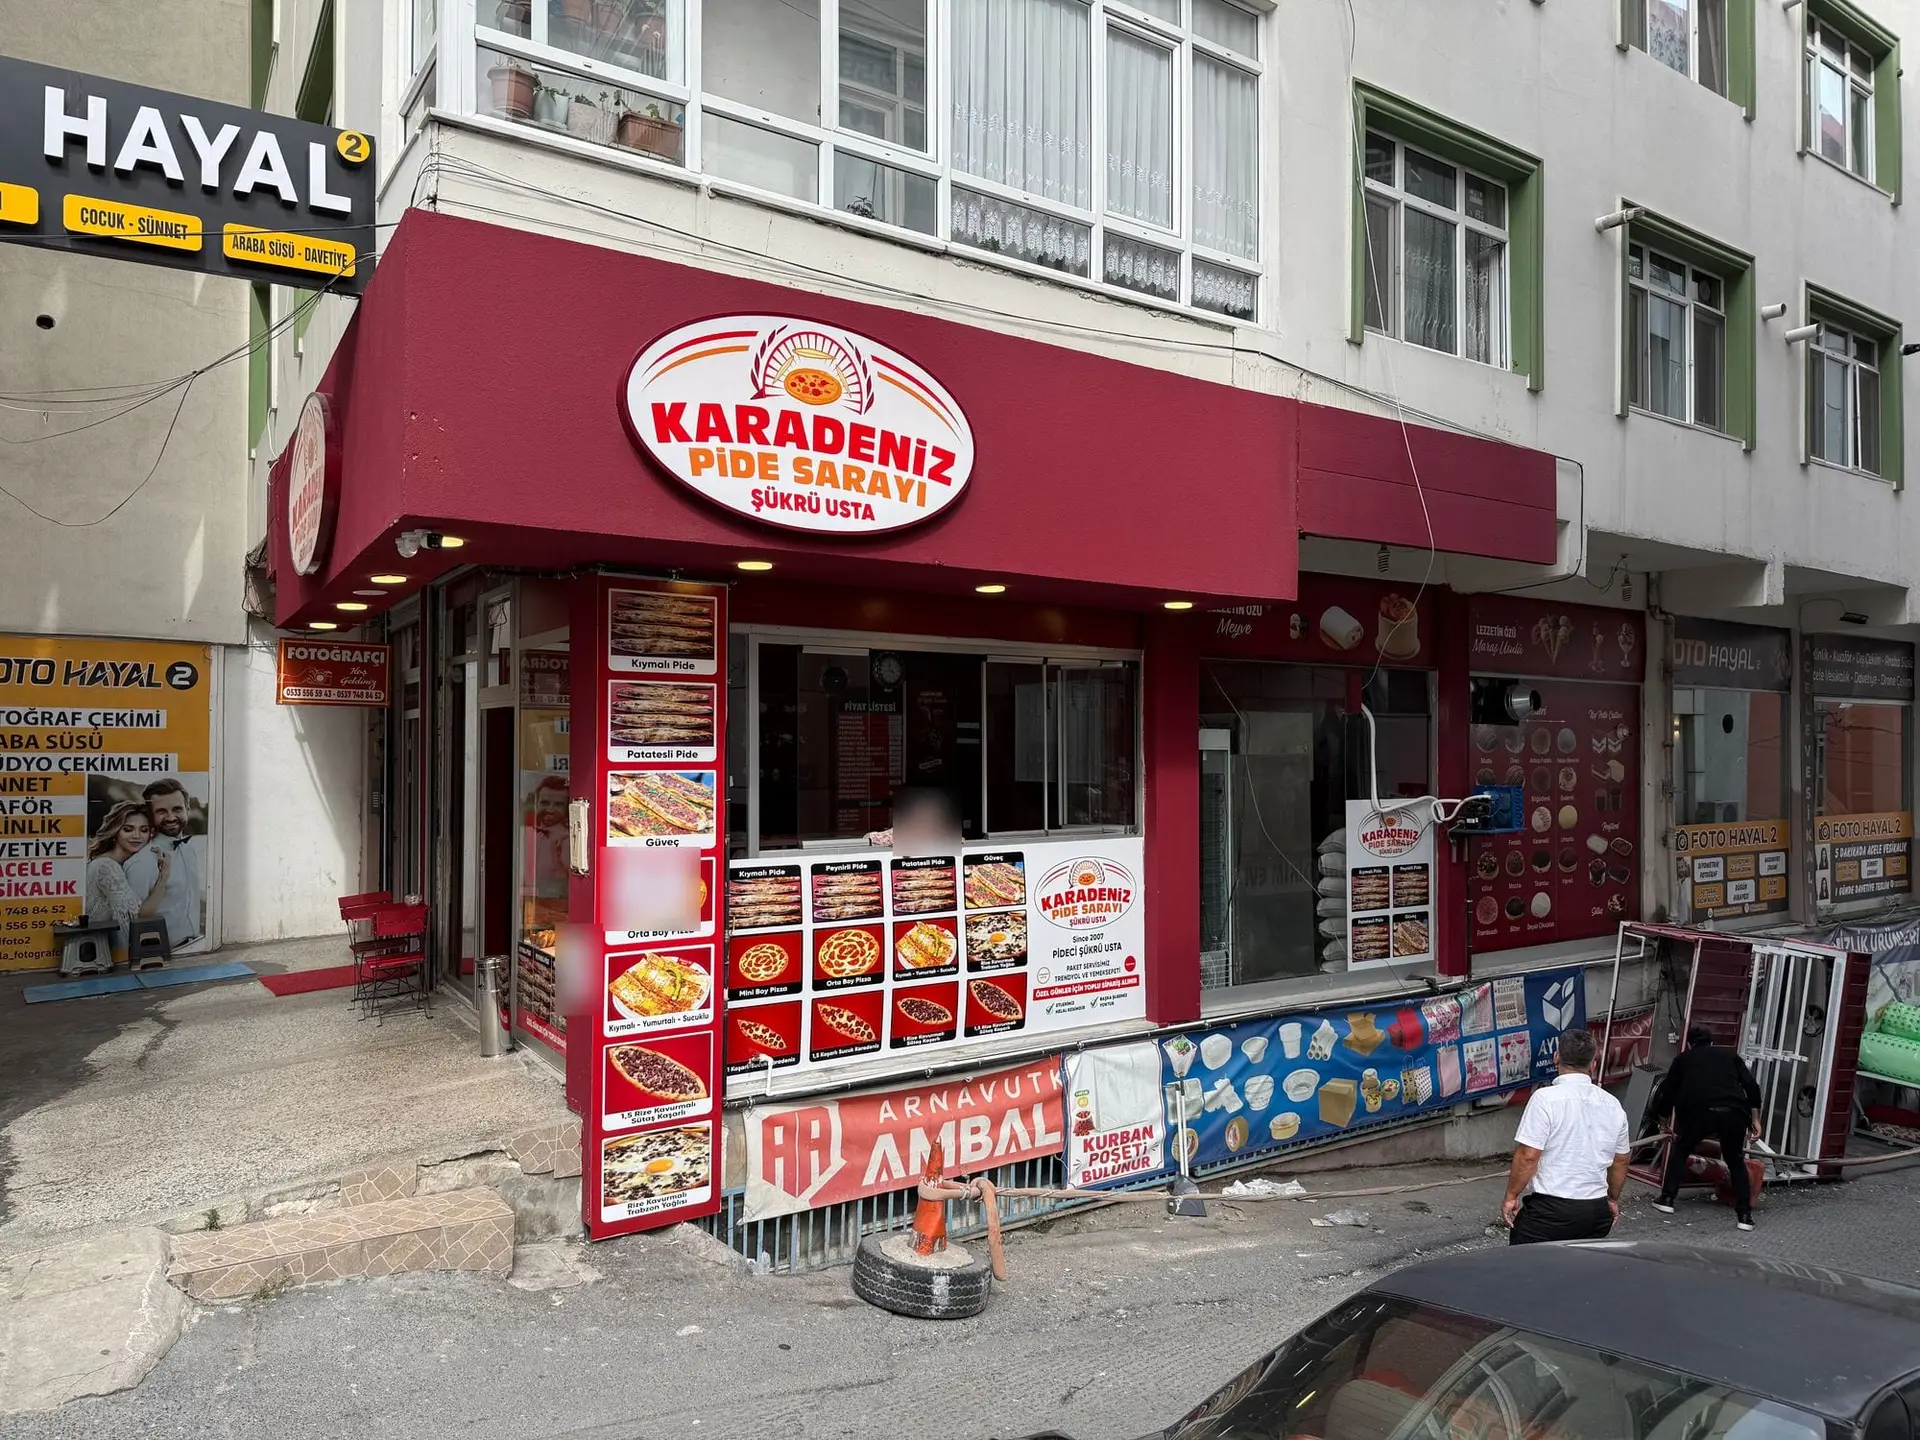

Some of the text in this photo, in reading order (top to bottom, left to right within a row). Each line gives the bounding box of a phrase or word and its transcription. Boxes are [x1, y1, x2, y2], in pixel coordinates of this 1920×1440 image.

[44, 86, 363, 213] HAYAL 2
[81, 207, 188, 241] ÇOCUK SÜNNET
[232, 234, 348, 269] ARABA SÜSÜ DAVETİYE
[791, 457, 927, 508] SARAYI
[750, 486, 876, 521] ŞÜKRÜ USTA
[287, 646, 385, 667] FOTOĞRAFÇI
[631, 658, 696, 671] Kıymalı Pide
[1709, 645, 1755, 671] HAYAL
[63, 660, 162, 689] HAYAL
[171, 666, 193, 686] 2
[88, 709, 161, 731] ÇEKİMİ
[46, 732, 103, 750] SÜSÜ
[627, 749, 699, 760] Patatesli Pide
[0, 754, 169, 776] DYO ÇEKİMLERİ
[0, 816, 62, 835] İNLİK
[1832, 819, 1901, 839] FOTO HAYAL 2
[645, 837, 680, 848] Güveç
[1691, 826, 1777, 849] FOTO HAYAL 2
[5, 905, 66, 916] 748 84 52
[1082, 903, 1122, 915] SARAYI
[6, 921, 28, 930] 556
[31, 920, 46, 929] 59
[1069, 916, 1107, 928] ŞÜKRÜ USTA
[0, 936, 31, 946] foto2
[1073, 933, 1104, 943] Since 2007
[1053, 942, 1122, 959] PİDECİ ŞÜKRÜ USTA
[843, 978, 855, 986] Boy
[755, 988, 768, 996] Boy
[608, 1013, 710, 1032] Kıymalı Yumurtalı Sucuklu
[878, 1068, 1064, 1124] ARNAVUTK
[634, 1109, 652, 1118] Rize
[654, 1102, 696, 1113] Kavurmalı
[657, 1109, 686, 1120] Kaşarlı
[862, 1102, 1061, 1186] AMBAL
[1083, 1125, 1154, 1153] KURBAN
[1088, 1142, 1147, 1167] POŞETİ
[1082, 1156, 1151, 1183] BULUNUR
[627, 1193, 687, 1209] Rize Kavurmalı
[627, 1205, 660, 1216] Trabzon
